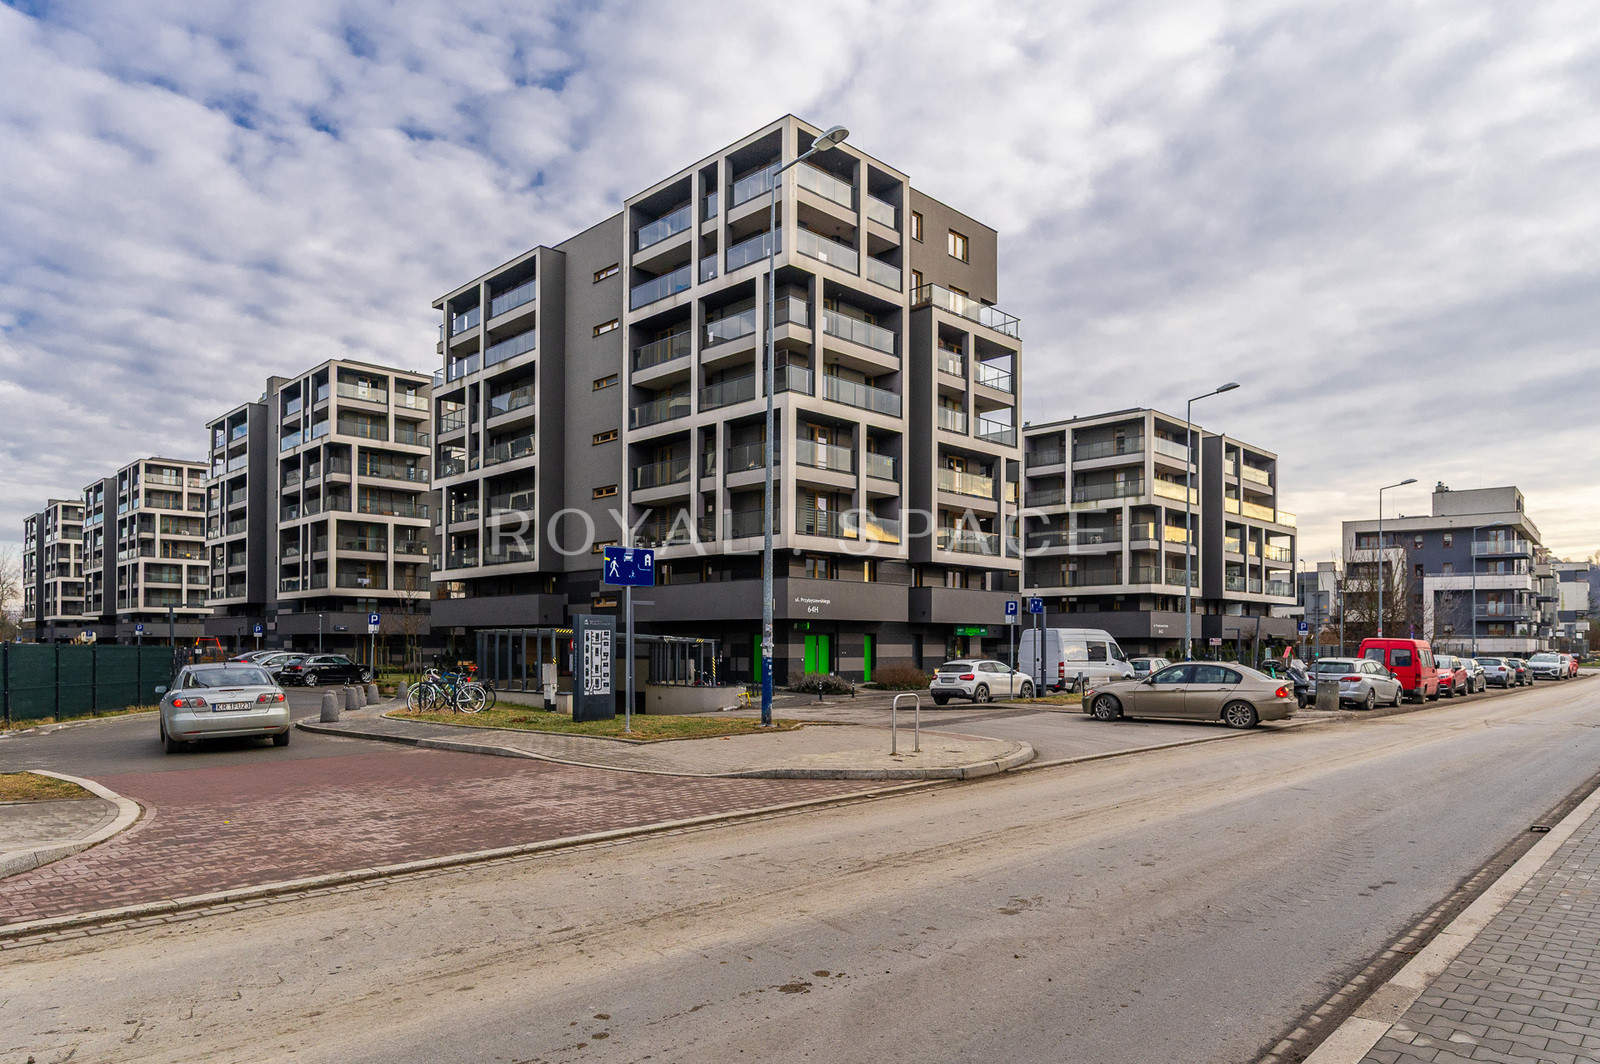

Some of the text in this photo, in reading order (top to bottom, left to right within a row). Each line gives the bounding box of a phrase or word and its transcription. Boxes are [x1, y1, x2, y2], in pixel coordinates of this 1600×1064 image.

[1007, 602, 1016, 613] P
[371, 614, 378, 624] P
[255, 625, 261, 633] P
[1301, 622, 1306, 630] P
[215, 703, 228, 711] KR
